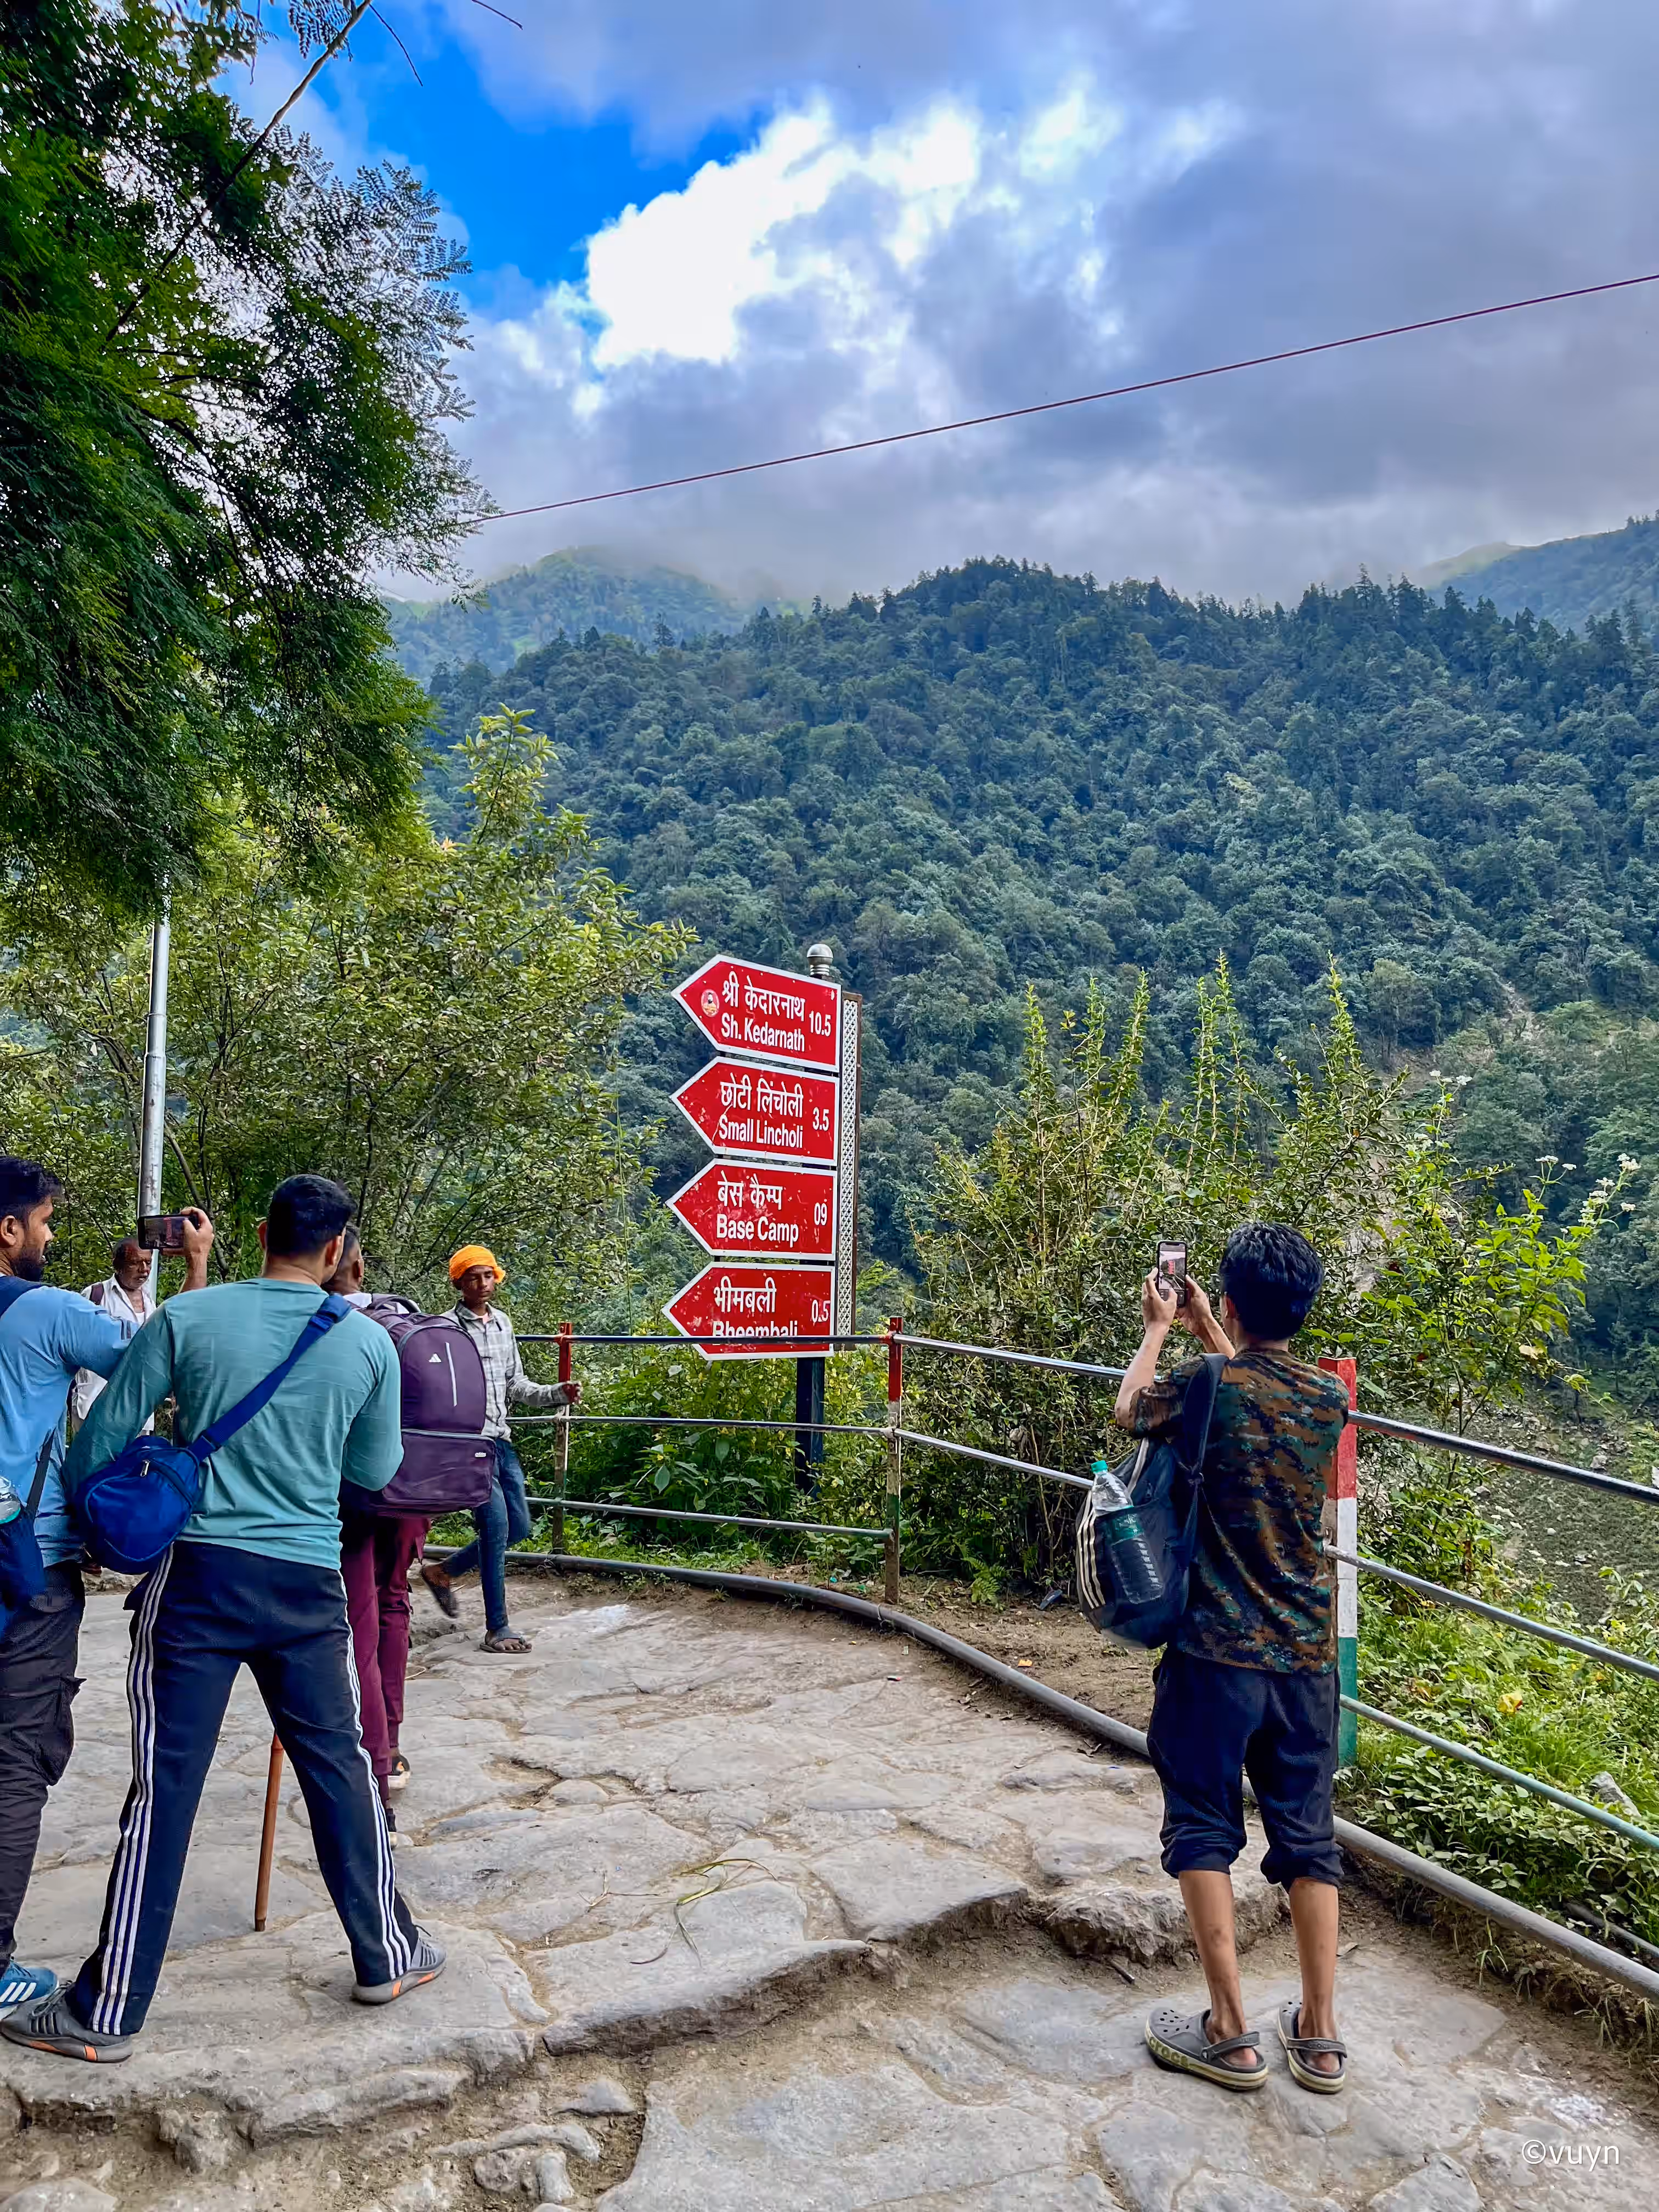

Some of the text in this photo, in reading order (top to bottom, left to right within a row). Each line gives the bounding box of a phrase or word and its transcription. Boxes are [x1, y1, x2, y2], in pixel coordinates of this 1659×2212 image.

[721, 970, 805, 1022] श्री केदारनाथ
[721, 1012, 805, 1052] Sh. Kedarnath
[809, 1010, 831, 1037] 10.5
[720, 1072, 804, 1118] छोटी लिंचोली
[719, 1114, 803, 1148] Small Lincholi
[812, 1107, 830, 1131] 3.5
[717, 1170, 783, 1210] बेस कैम्प
[716, 1214, 799, 1248] Base Camp
[814, 1203, 827, 1226] 09
[714, 1276, 777, 1313] भीमबली
[811, 1299, 831, 1323] 0.5
